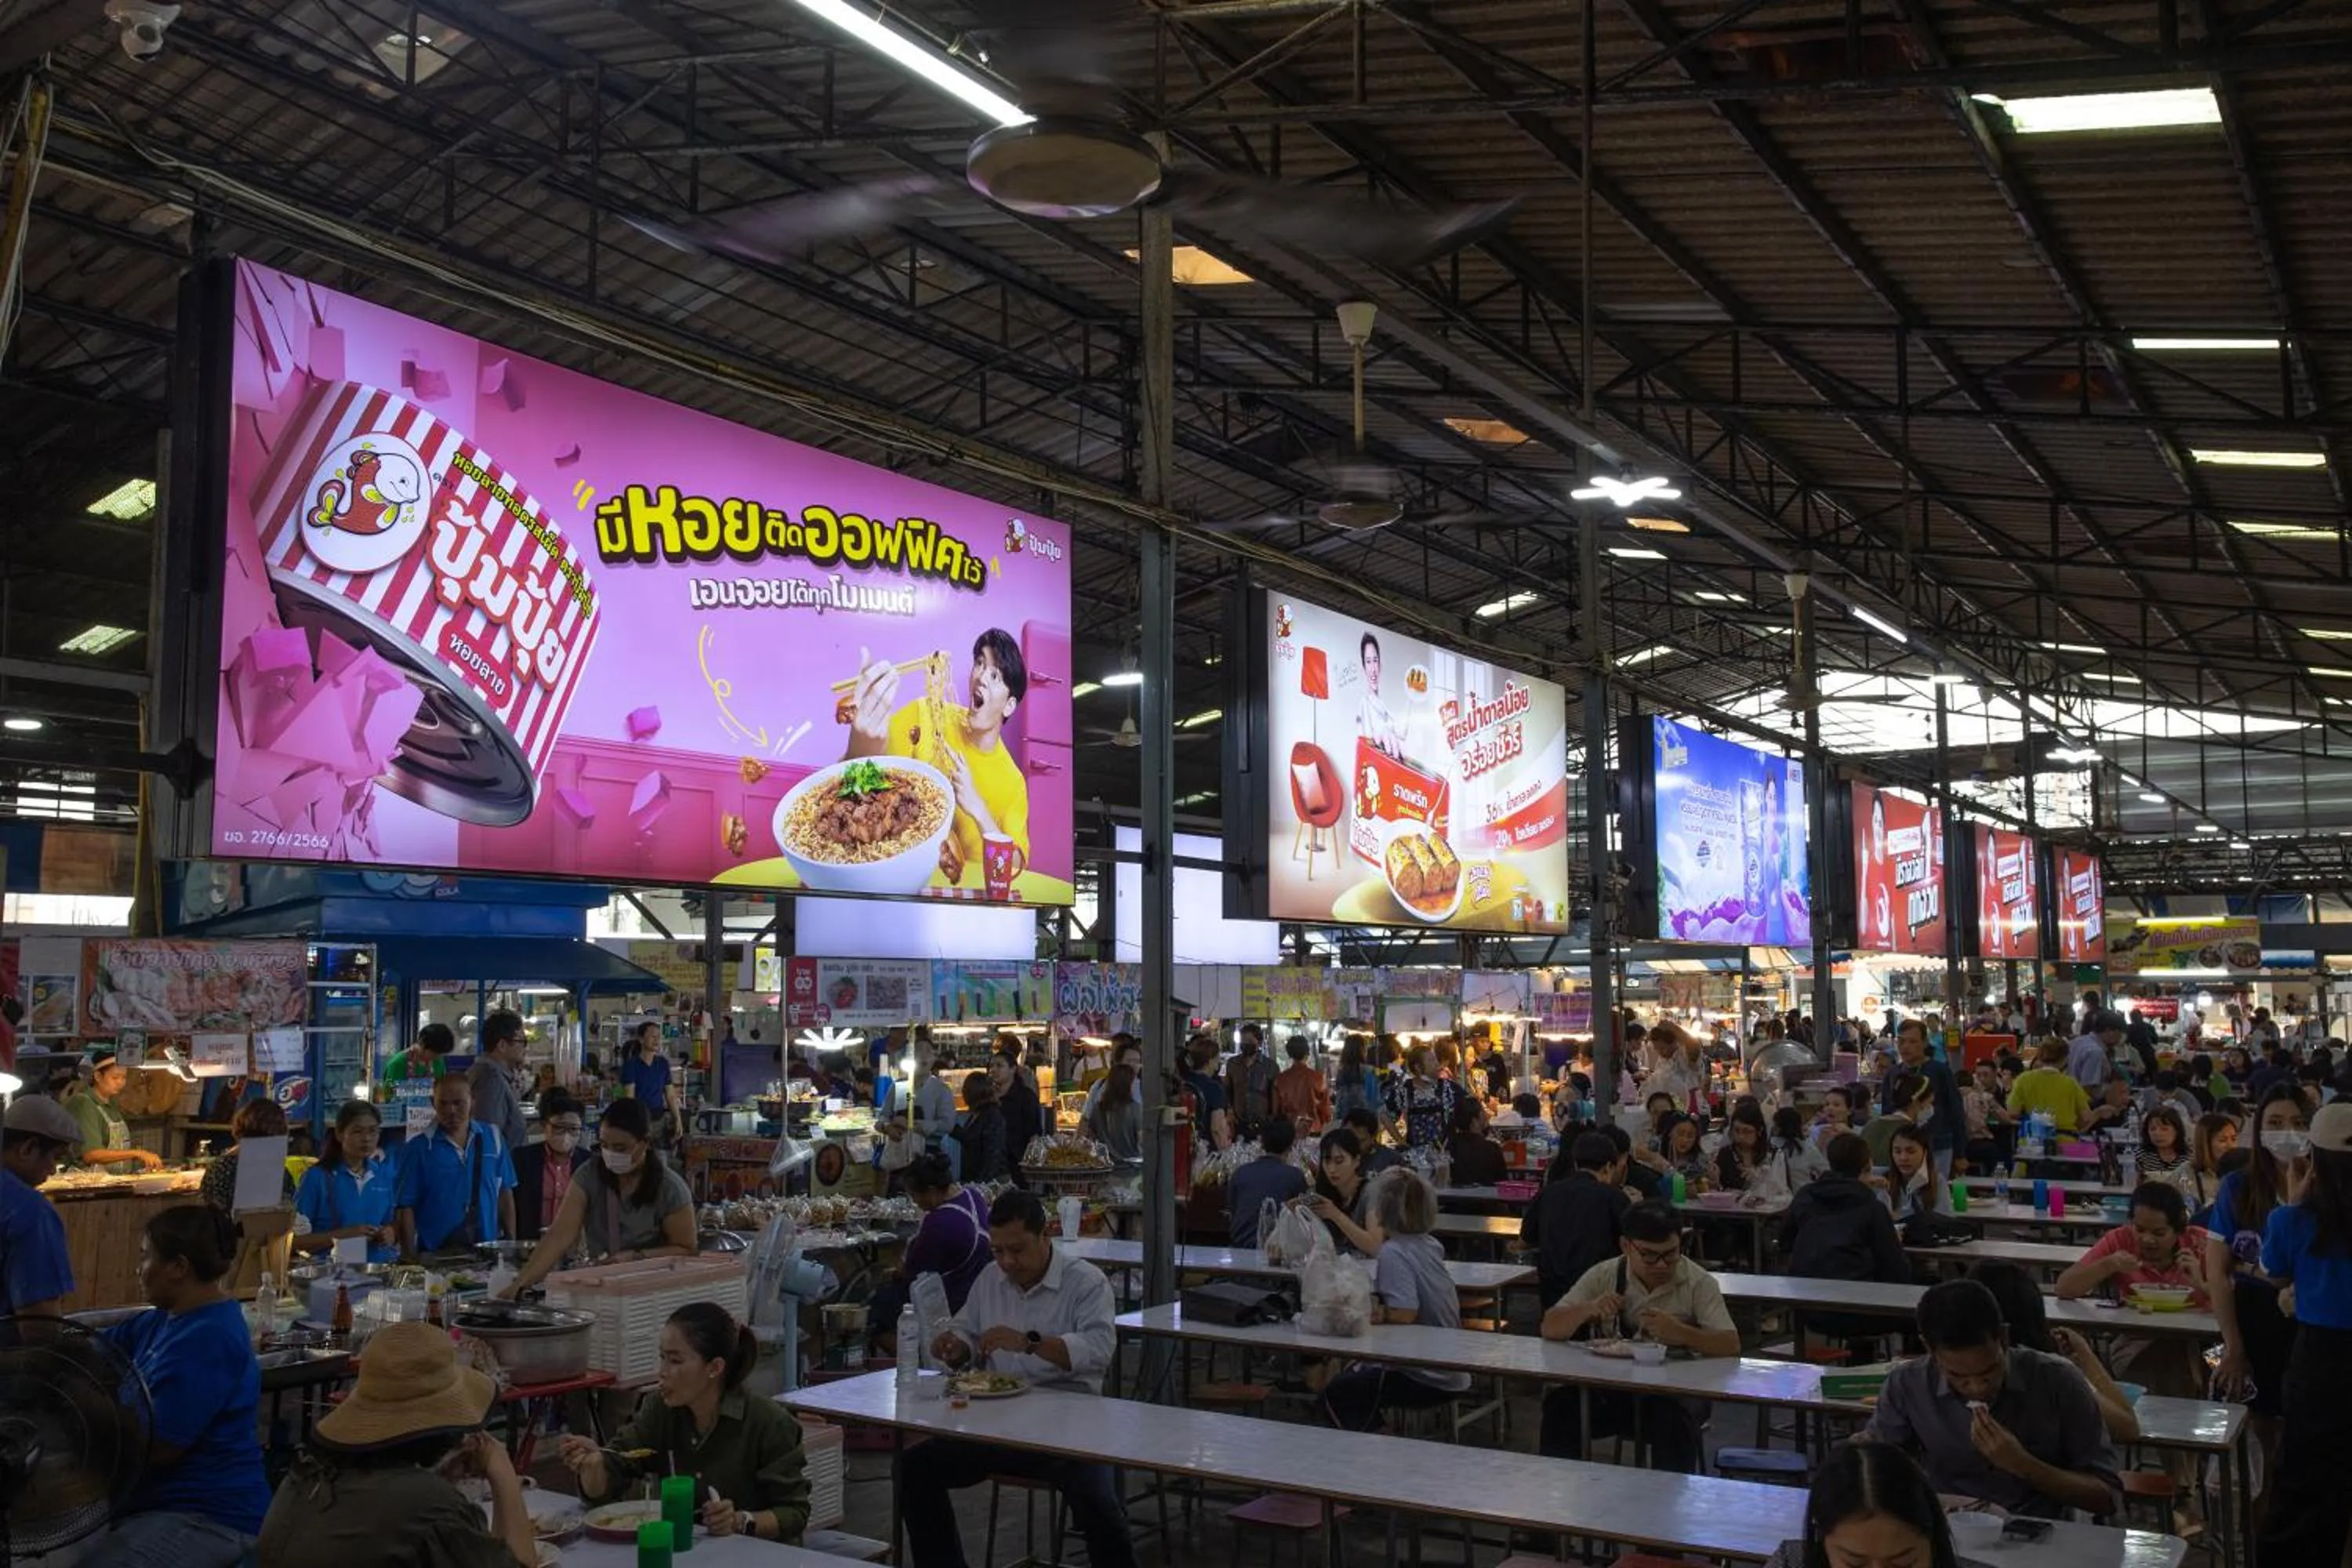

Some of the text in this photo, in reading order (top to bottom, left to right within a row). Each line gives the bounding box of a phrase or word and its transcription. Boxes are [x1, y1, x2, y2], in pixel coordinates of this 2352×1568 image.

[430, 497, 567, 688] ปุ้มปุ้ย
[449, 632, 506, 696] หอยลาย
[251, 829, 328, 848] 2766/2566
